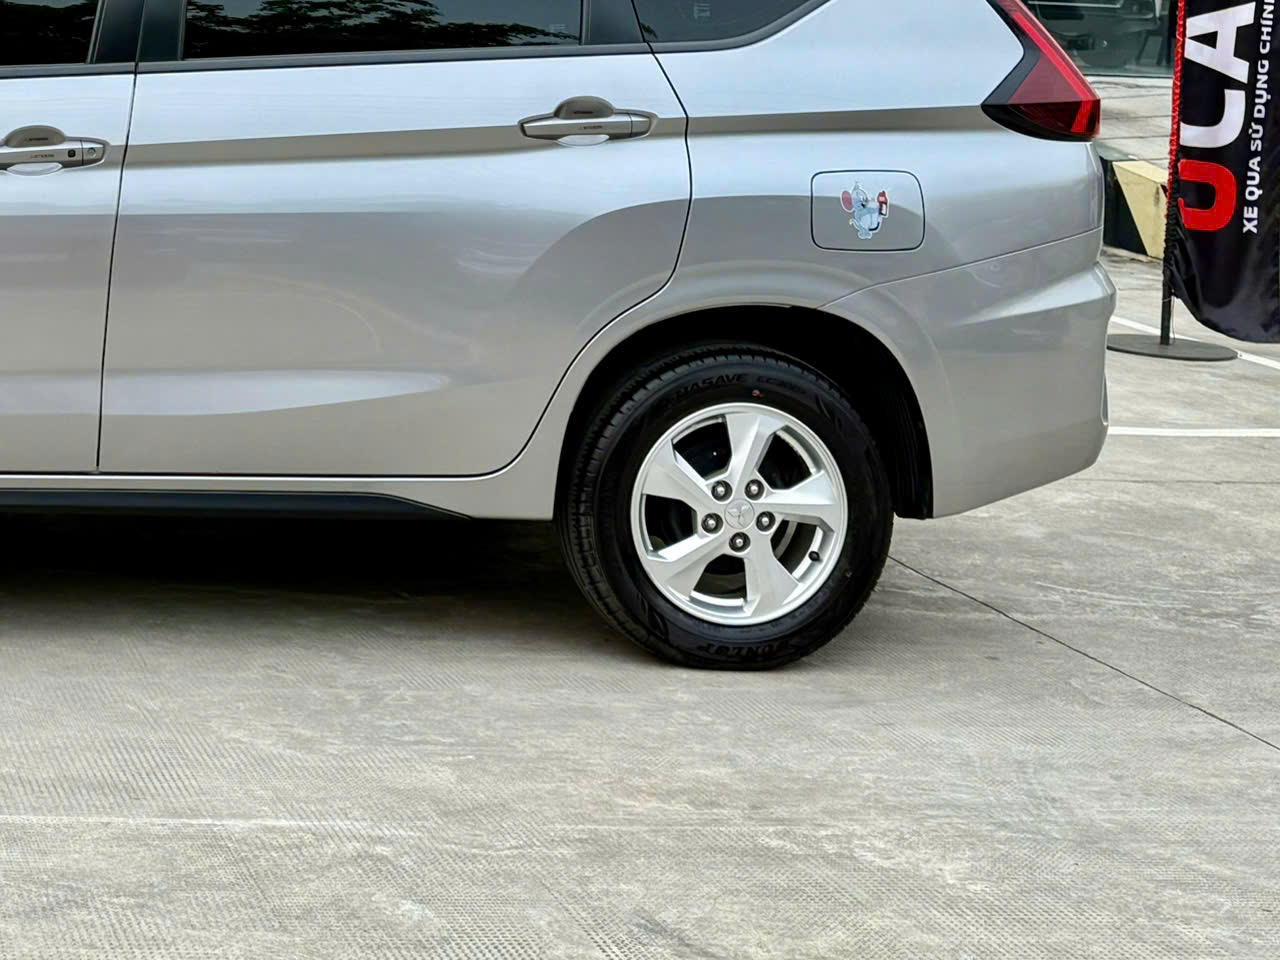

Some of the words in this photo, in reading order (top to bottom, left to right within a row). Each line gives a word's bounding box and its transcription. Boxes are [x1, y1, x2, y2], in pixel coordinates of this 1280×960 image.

[1253, 59, 1272, 119] DỤNG
[1248, 121, 1263, 152] SỬ
[1245, 156, 1263, 204] QUA
[1242, 205, 1259, 234] XE
